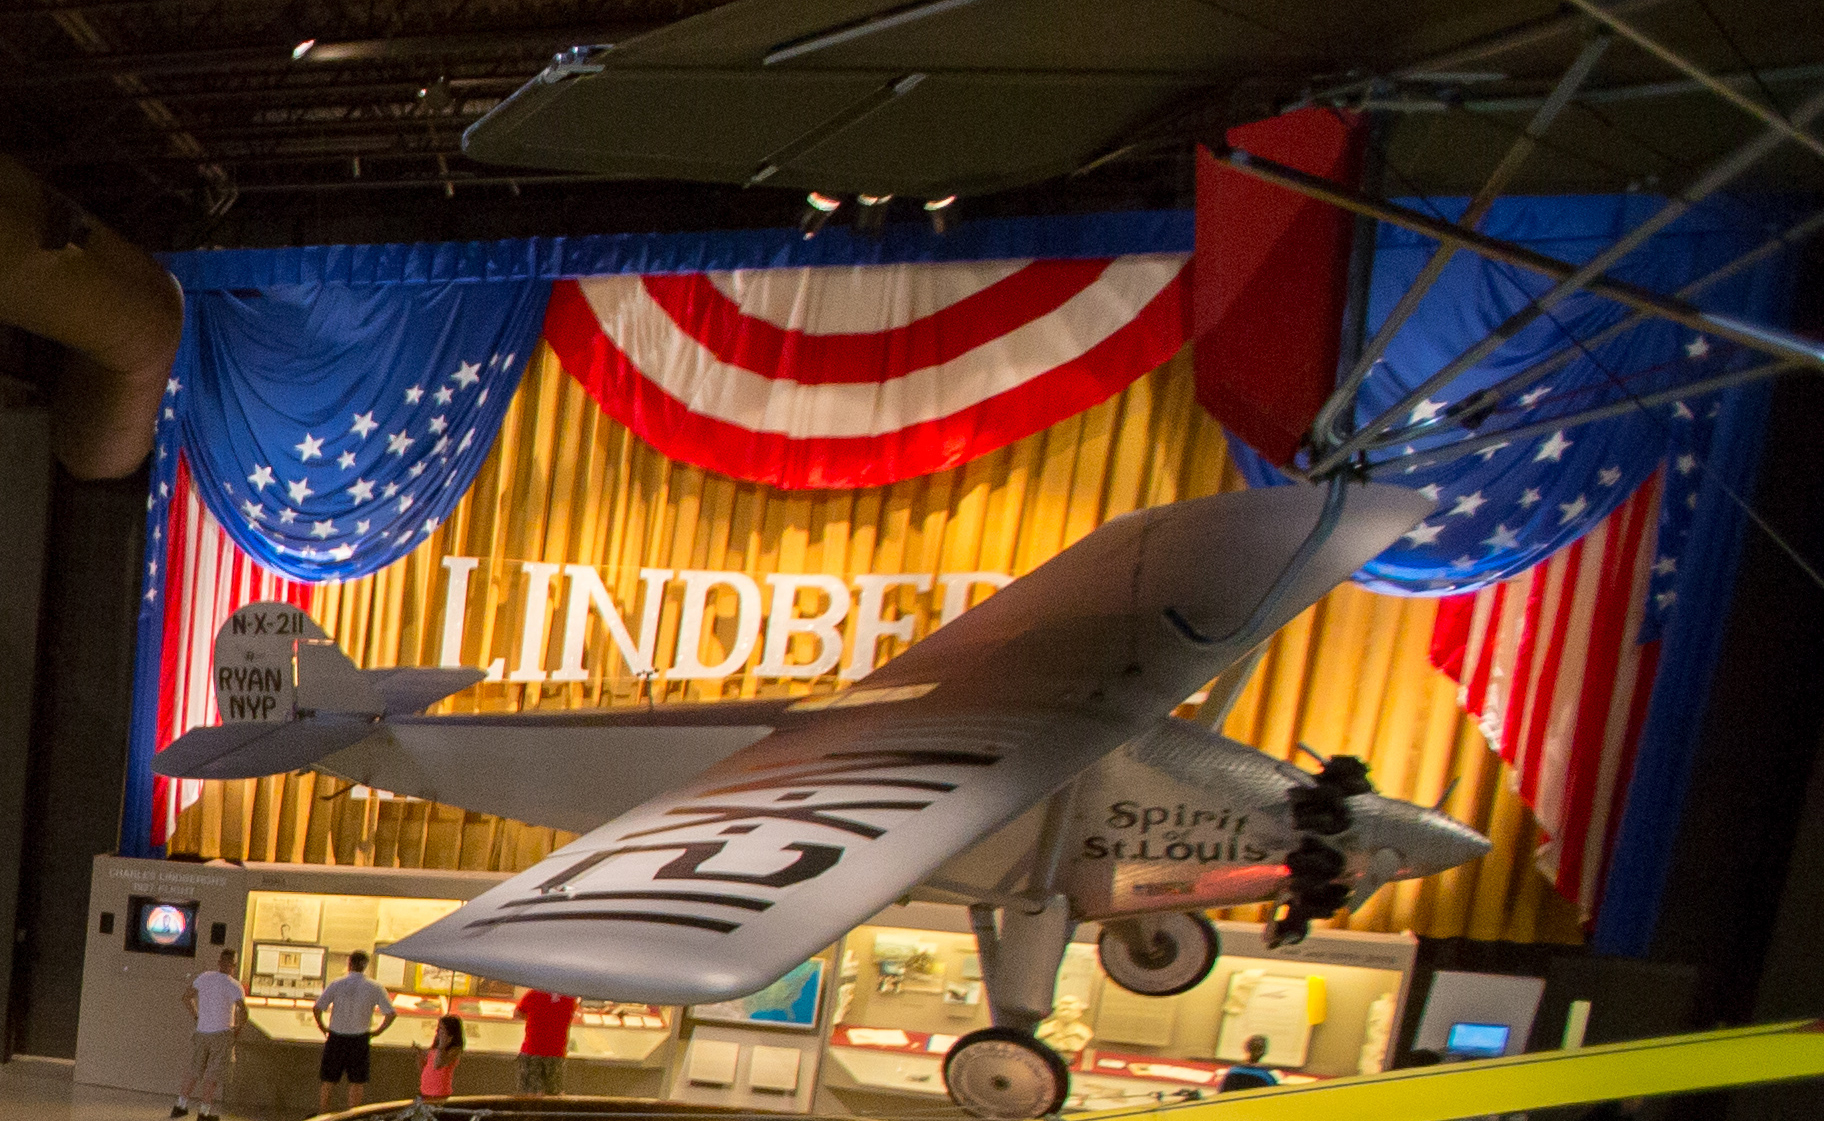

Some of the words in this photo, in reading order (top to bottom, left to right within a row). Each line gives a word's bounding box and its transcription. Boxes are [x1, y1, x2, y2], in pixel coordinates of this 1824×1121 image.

[232, 612, 304, 635] N-X-211
[218, 667, 282, 692] RYAN
[229, 695, 277, 719] NYP
[1107, 800, 1250, 834] Spirit
